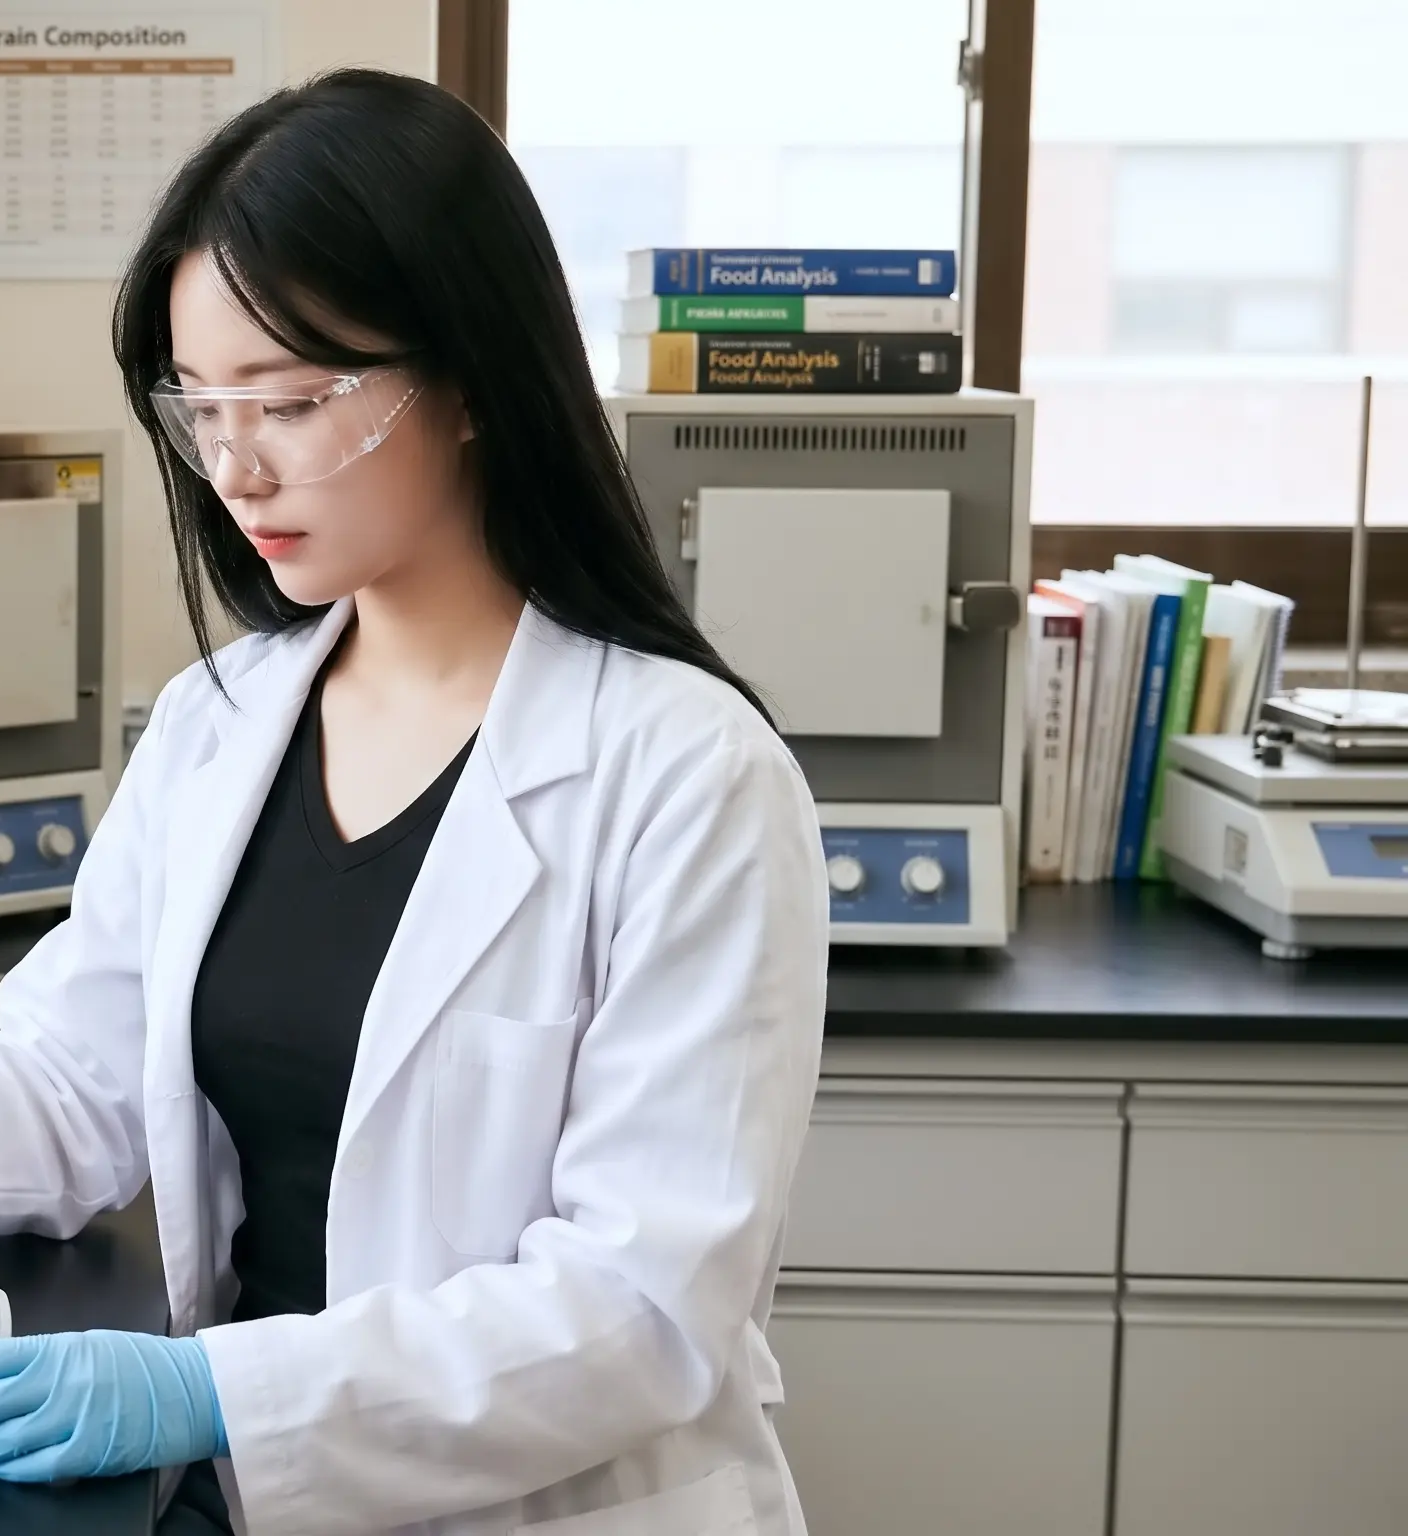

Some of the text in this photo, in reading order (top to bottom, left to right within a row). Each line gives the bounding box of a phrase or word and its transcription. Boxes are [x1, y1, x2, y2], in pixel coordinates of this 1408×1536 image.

[44, 26, 187, 51] Composition
[710, 266, 757, 285] Food
[760, 266, 838, 290] Analysis
[708, 350, 840, 372] Food Analysis
[708, 370, 814, 388] Food Analysis
